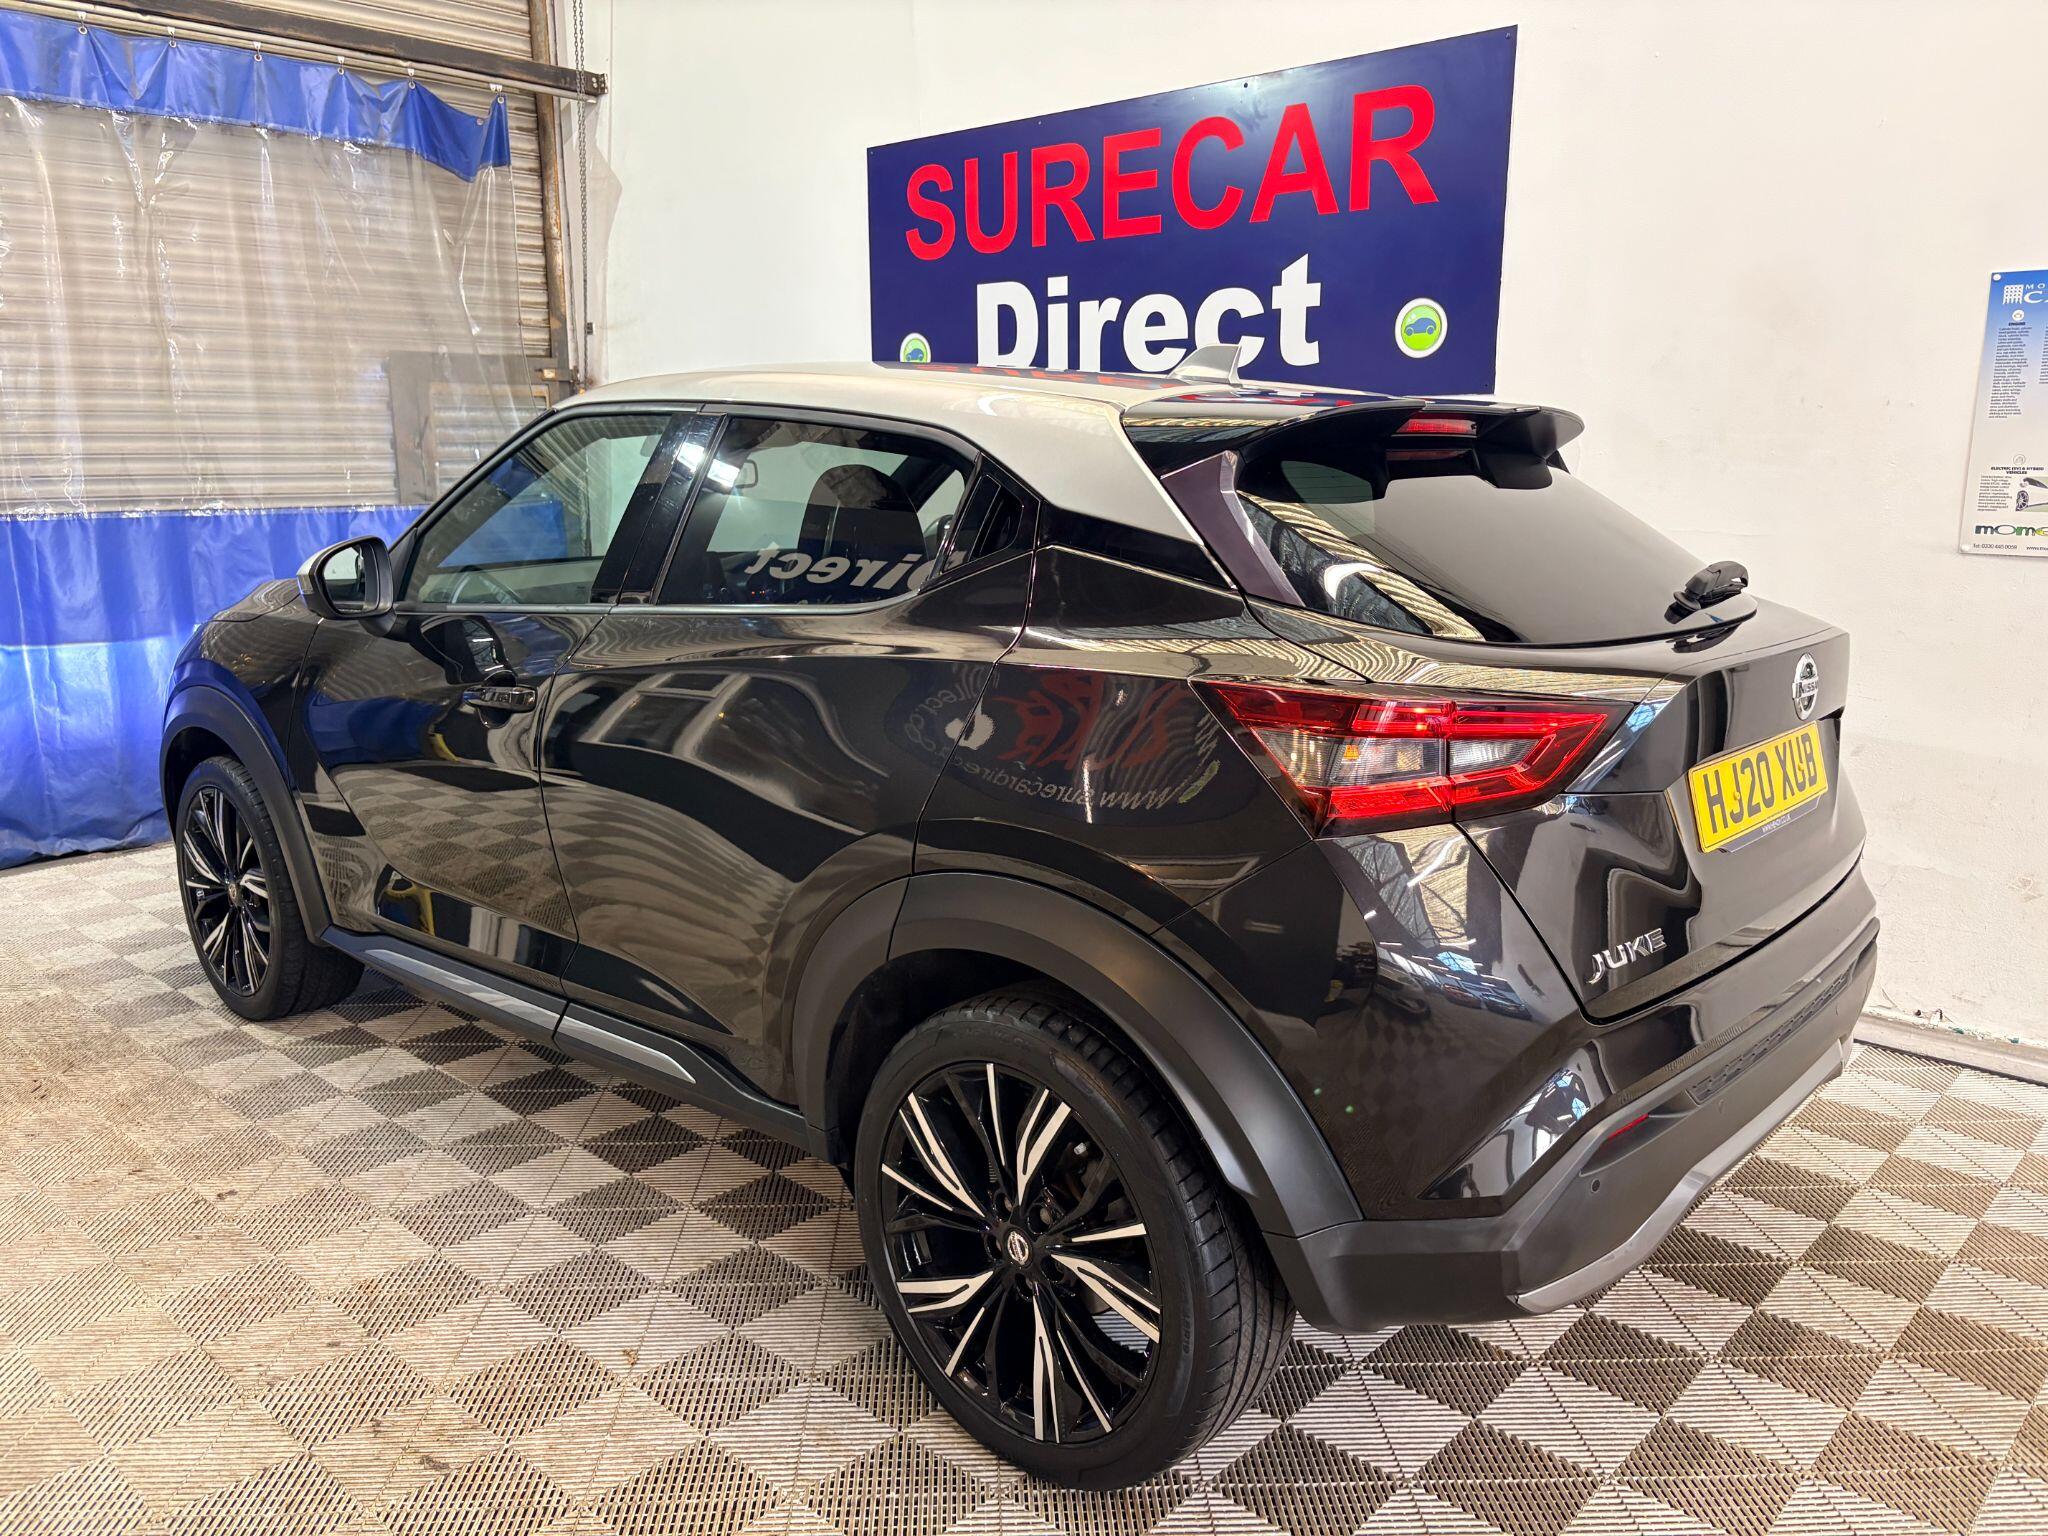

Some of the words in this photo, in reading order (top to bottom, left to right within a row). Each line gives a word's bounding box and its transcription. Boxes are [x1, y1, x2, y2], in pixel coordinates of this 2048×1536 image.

[905, 84, 1439, 261] SURECAR
[976, 253, 1322, 373] Direct
[1703, 751, 1775, 834] HJ20
[1774, 732, 1818, 801] XUB
[1586, 927, 1668, 985] JUKE
